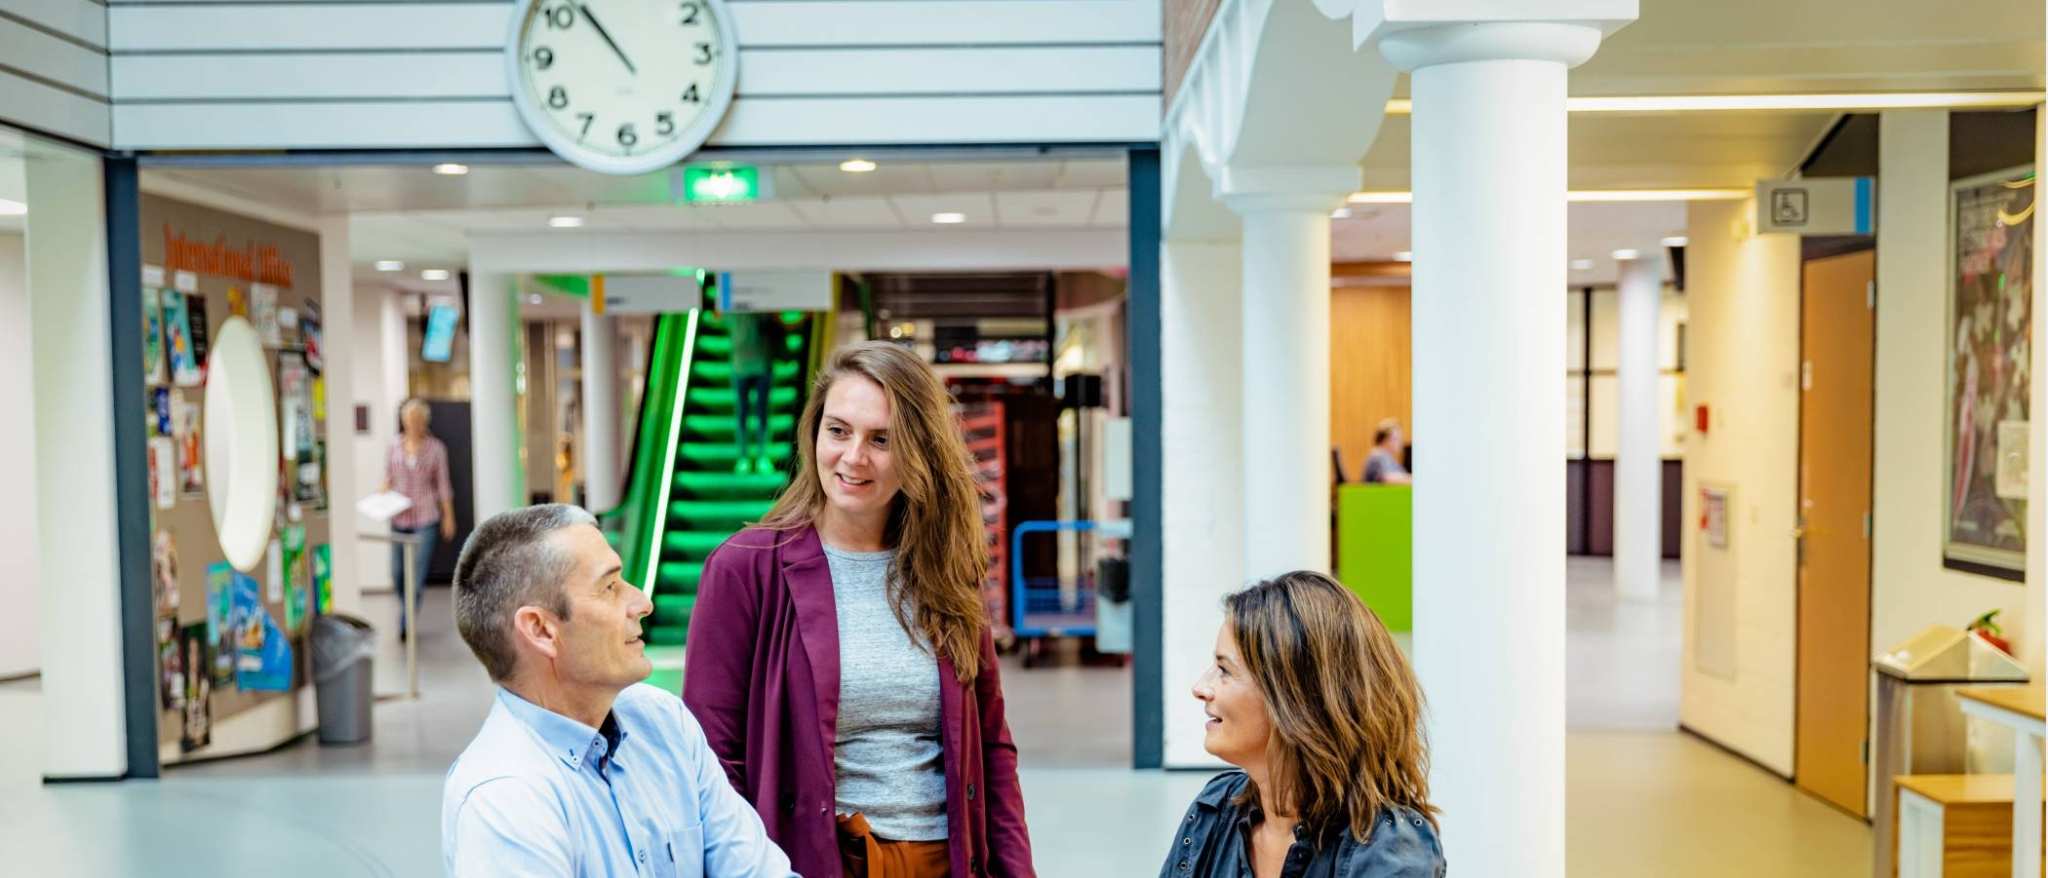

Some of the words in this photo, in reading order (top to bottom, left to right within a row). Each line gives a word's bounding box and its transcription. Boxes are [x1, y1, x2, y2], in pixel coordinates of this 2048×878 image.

[545, 6, 574, 29] 10
[681, 2, 699, 25] 2
[534, 48, 554, 70] 9
[694, 43, 712, 65] 3
[549, 87, 569, 109] 8
[682, 84, 699, 103] 4
[576, 113, 594, 137] 7
[617, 124, 637, 147] 6
[656, 112, 675, 136] 5
